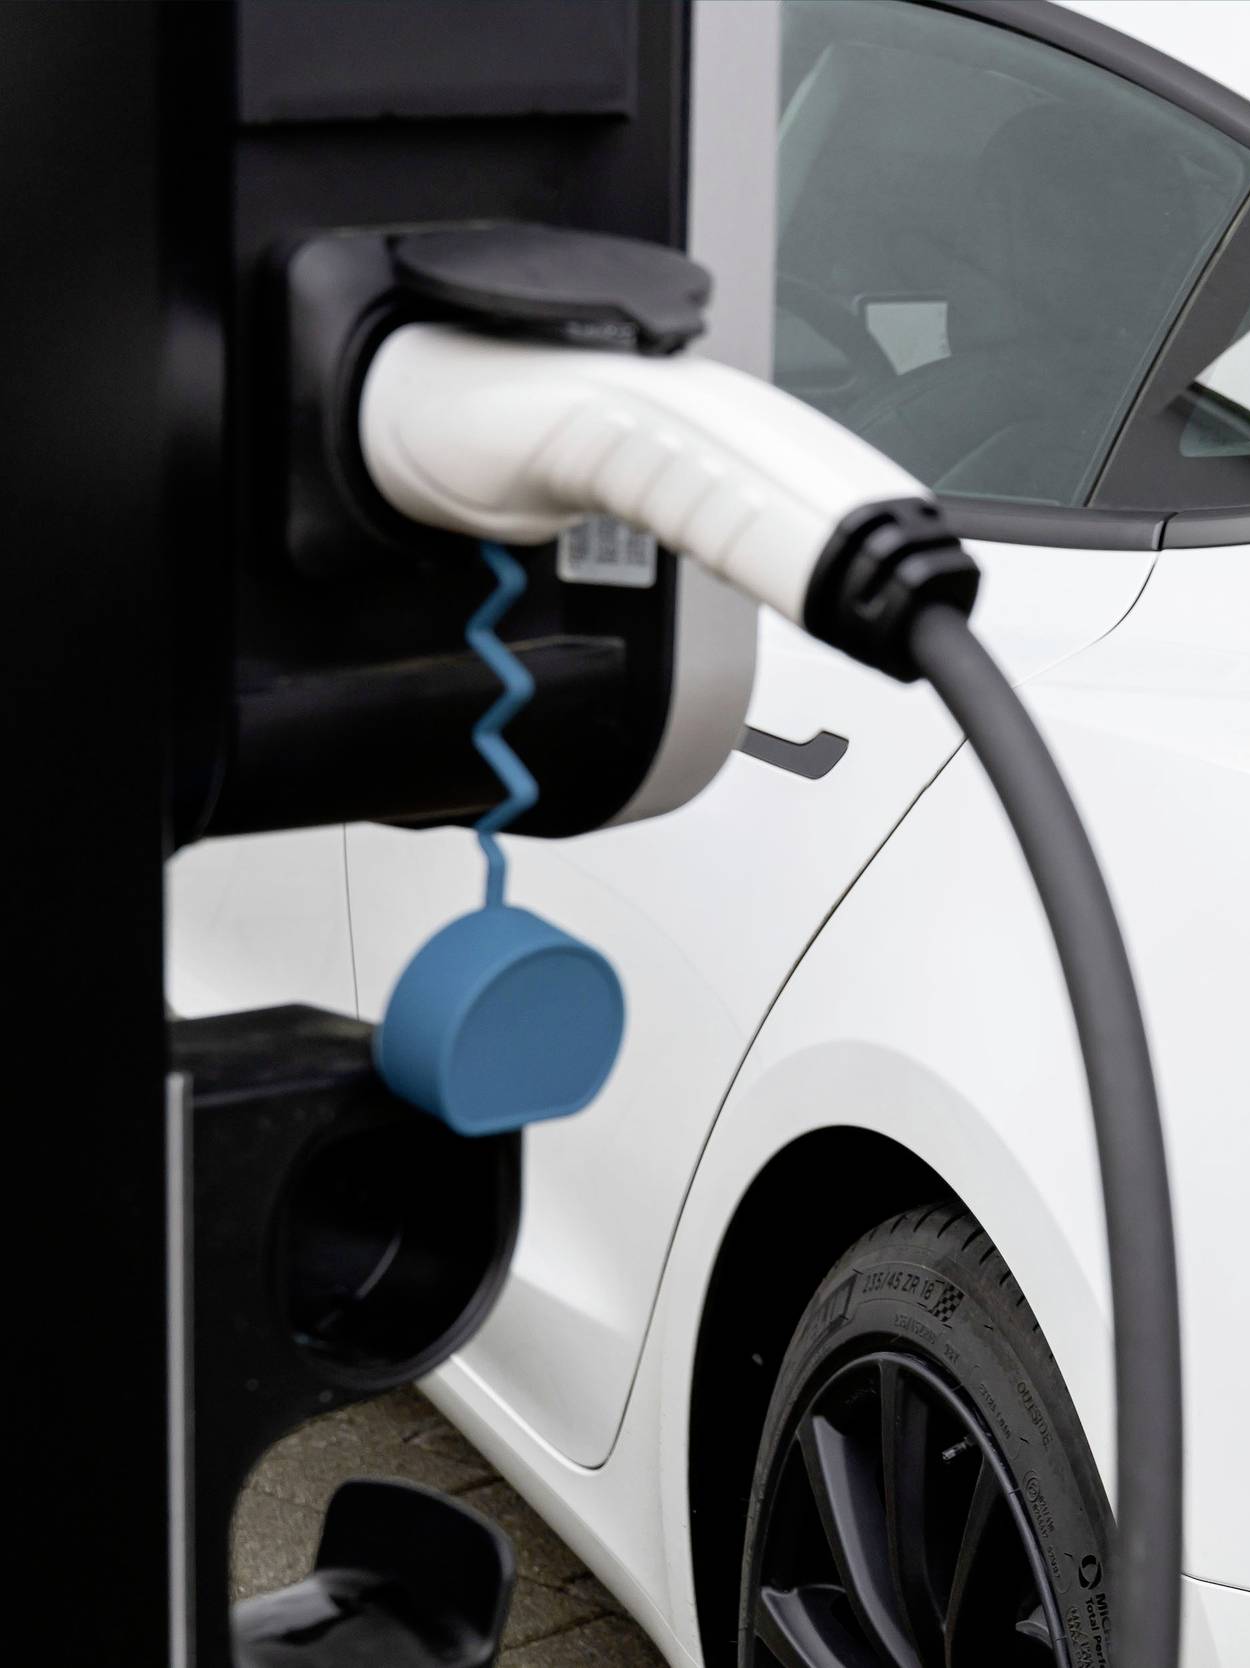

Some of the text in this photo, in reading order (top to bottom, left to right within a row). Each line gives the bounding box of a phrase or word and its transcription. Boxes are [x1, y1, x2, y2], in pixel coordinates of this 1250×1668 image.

[902, 1273, 920, 1295] ZR
[920, 1280, 934, 1300] 18
[1085, 1596, 1100, 1631] Total
